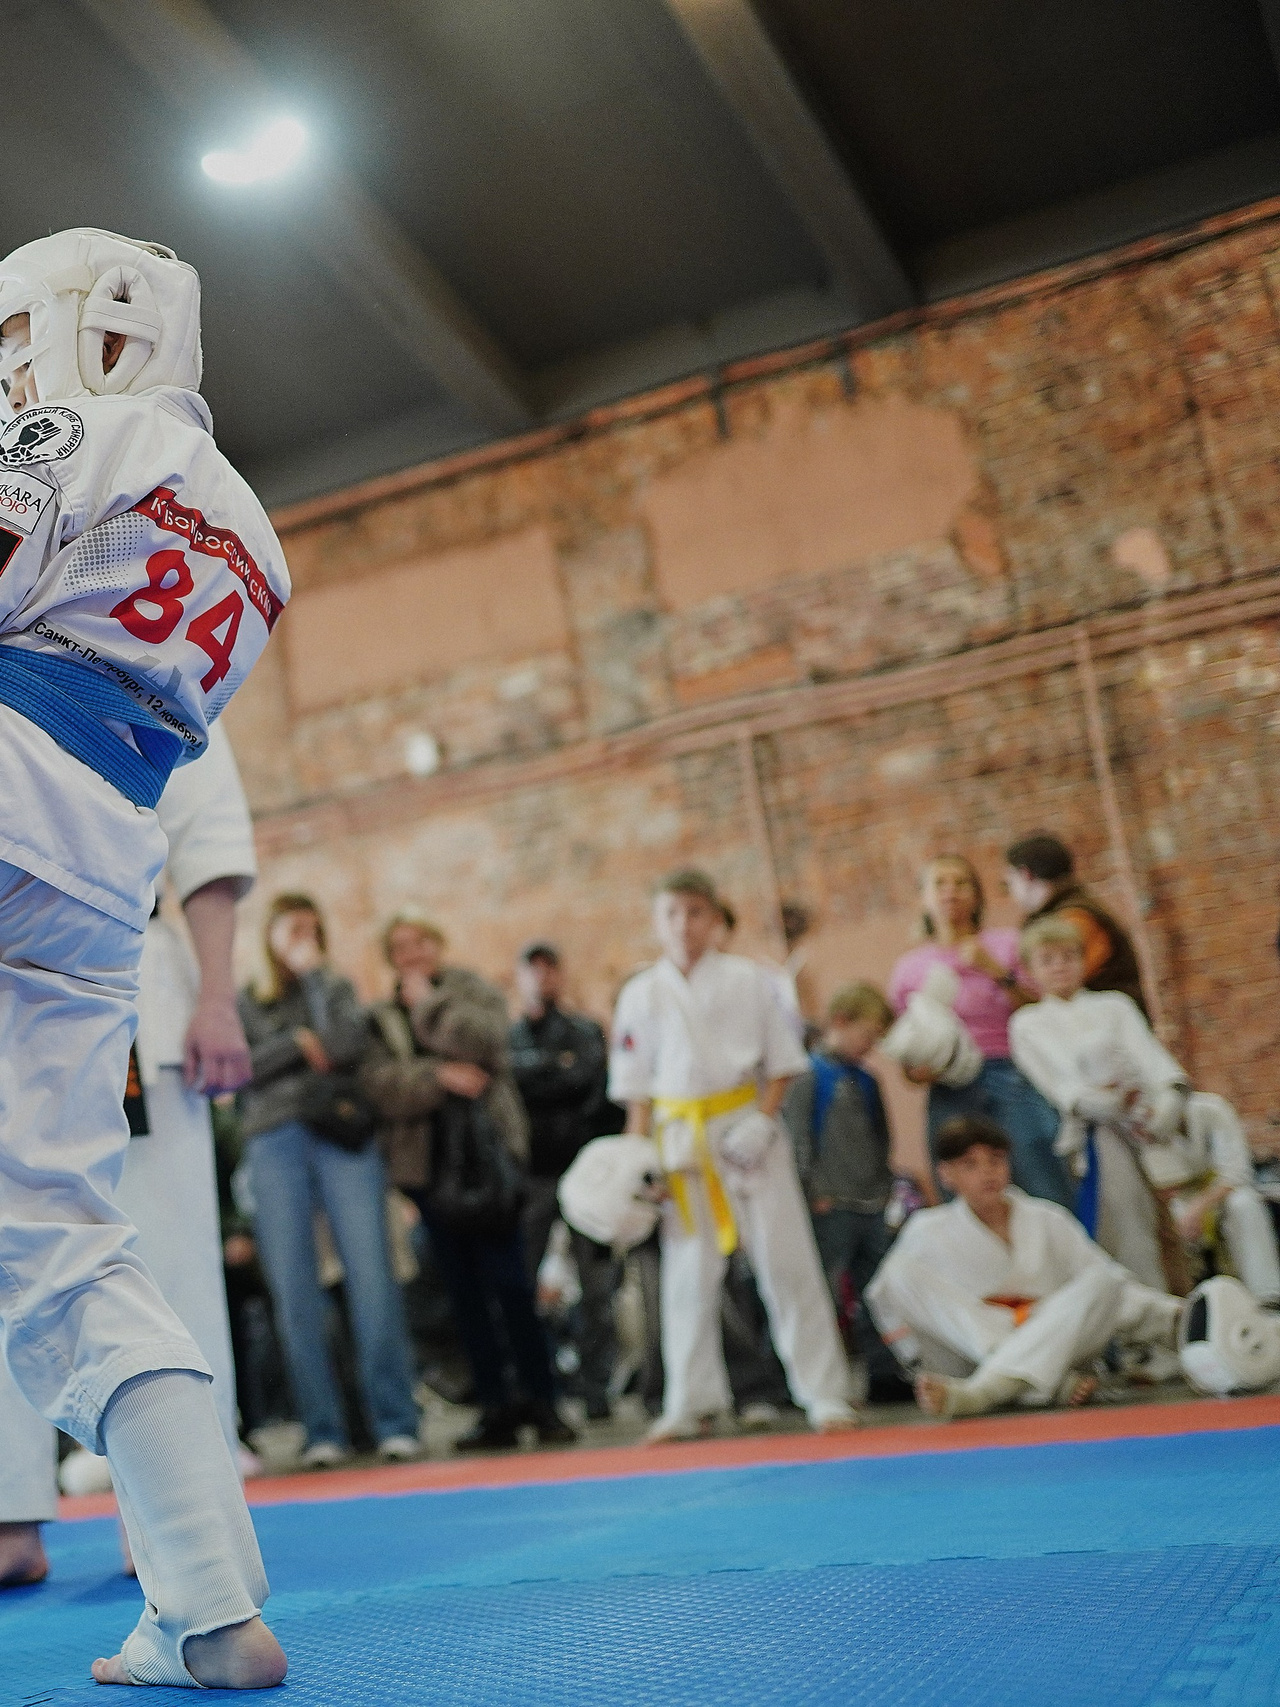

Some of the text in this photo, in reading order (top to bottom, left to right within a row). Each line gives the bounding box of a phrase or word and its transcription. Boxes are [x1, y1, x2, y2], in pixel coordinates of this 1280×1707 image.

[56, 424, 81, 457] СИНЕРГИЯ
[109, 549, 245, 694] 84
[146, 693, 164, 711] 12
[158, 709, 199, 746] ноября
